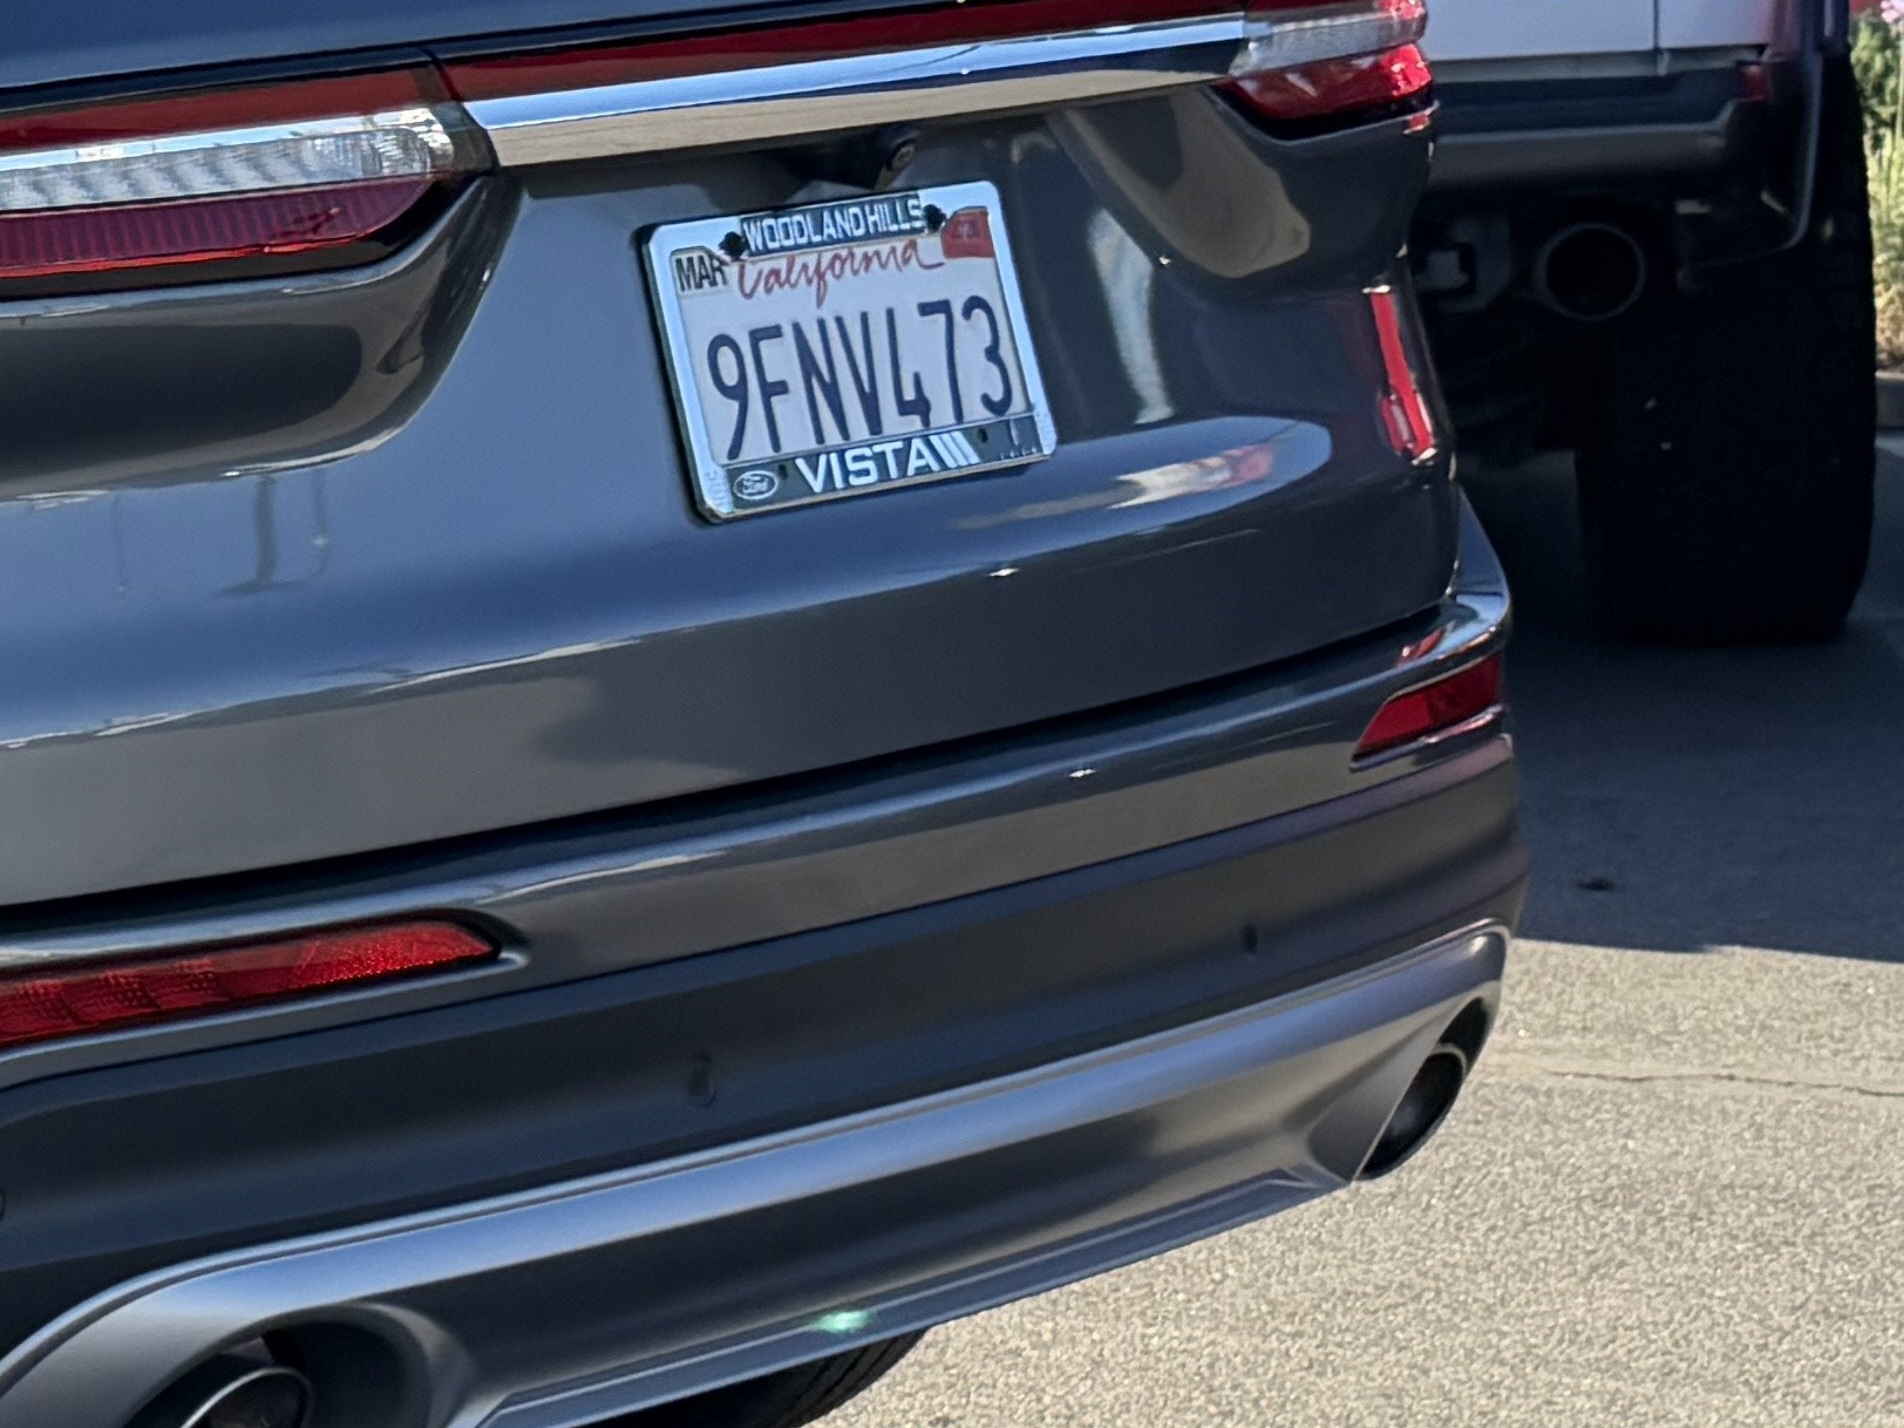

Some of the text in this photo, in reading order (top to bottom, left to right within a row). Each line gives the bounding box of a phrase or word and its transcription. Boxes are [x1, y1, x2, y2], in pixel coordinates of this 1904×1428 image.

[743, 206, 868, 253] WOODLAND
[867, 197, 925, 236] HILLS
[737, 239, 946, 307] California
[706, 294, 1013, 461] 9FNV473
[795, 437, 940, 493] VISTA
